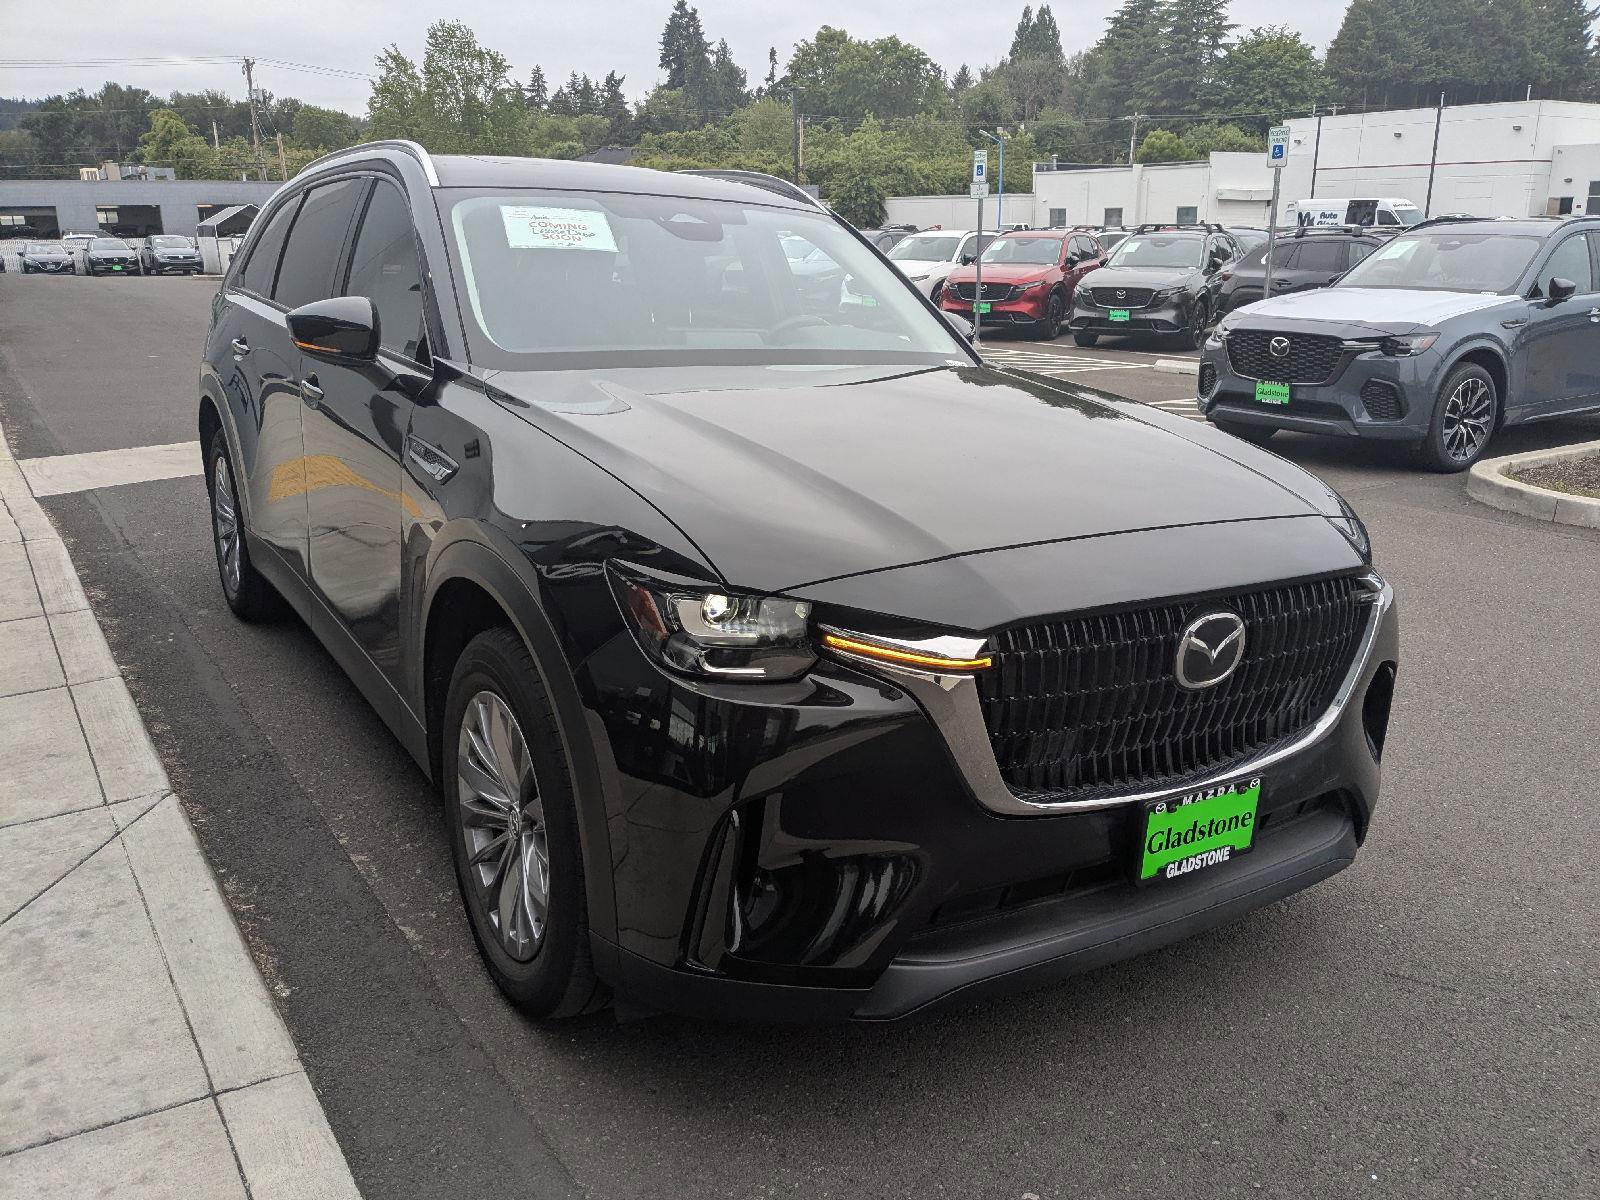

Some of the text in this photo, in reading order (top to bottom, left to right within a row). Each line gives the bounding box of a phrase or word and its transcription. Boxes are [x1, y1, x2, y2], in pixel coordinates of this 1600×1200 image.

[1256, 387, 1289, 397] Gladstone
[1182, 784, 1235, 806] MAZDA
[1147, 811, 1253, 854] Gladstone
[1166, 846, 1231, 879] GLADSTONE
